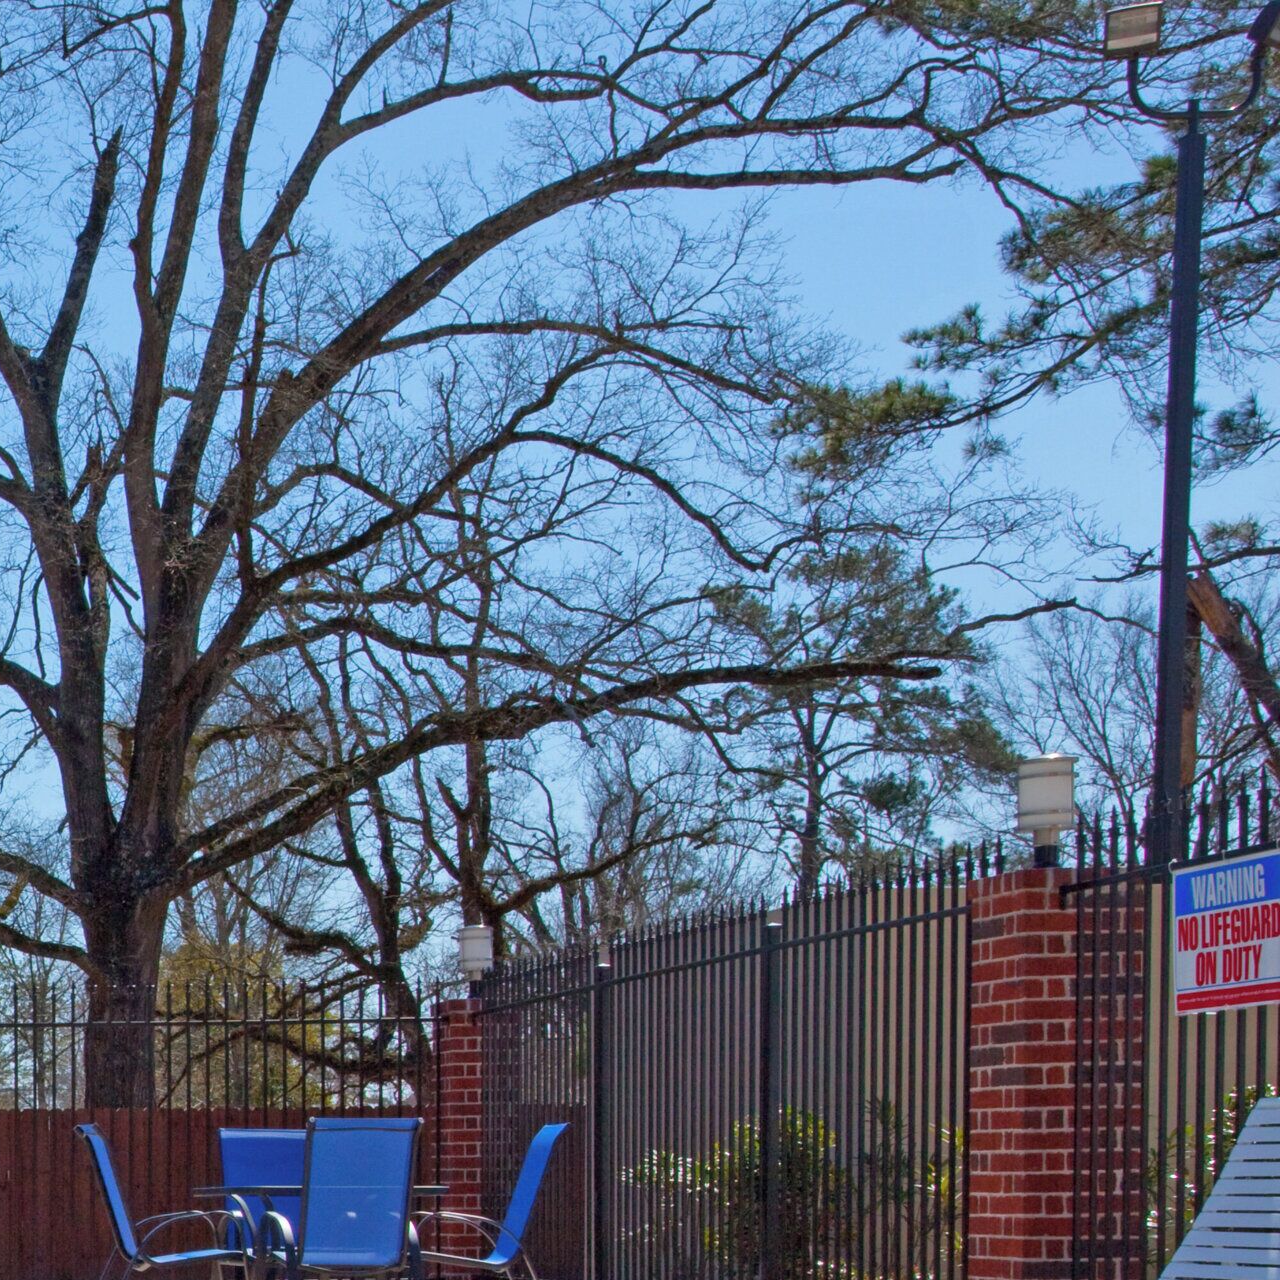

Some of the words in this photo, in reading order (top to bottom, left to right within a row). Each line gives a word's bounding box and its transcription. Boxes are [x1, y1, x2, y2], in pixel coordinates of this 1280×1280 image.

[1191, 863, 1266, 910] WARNING
[1178, 916, 1199, 952] NO
[1201, 902, 1280, 949] LIFEGUARD
[1195, 950, 1217, 987] ON
[1222, 944, 1262, 984] DUTY
